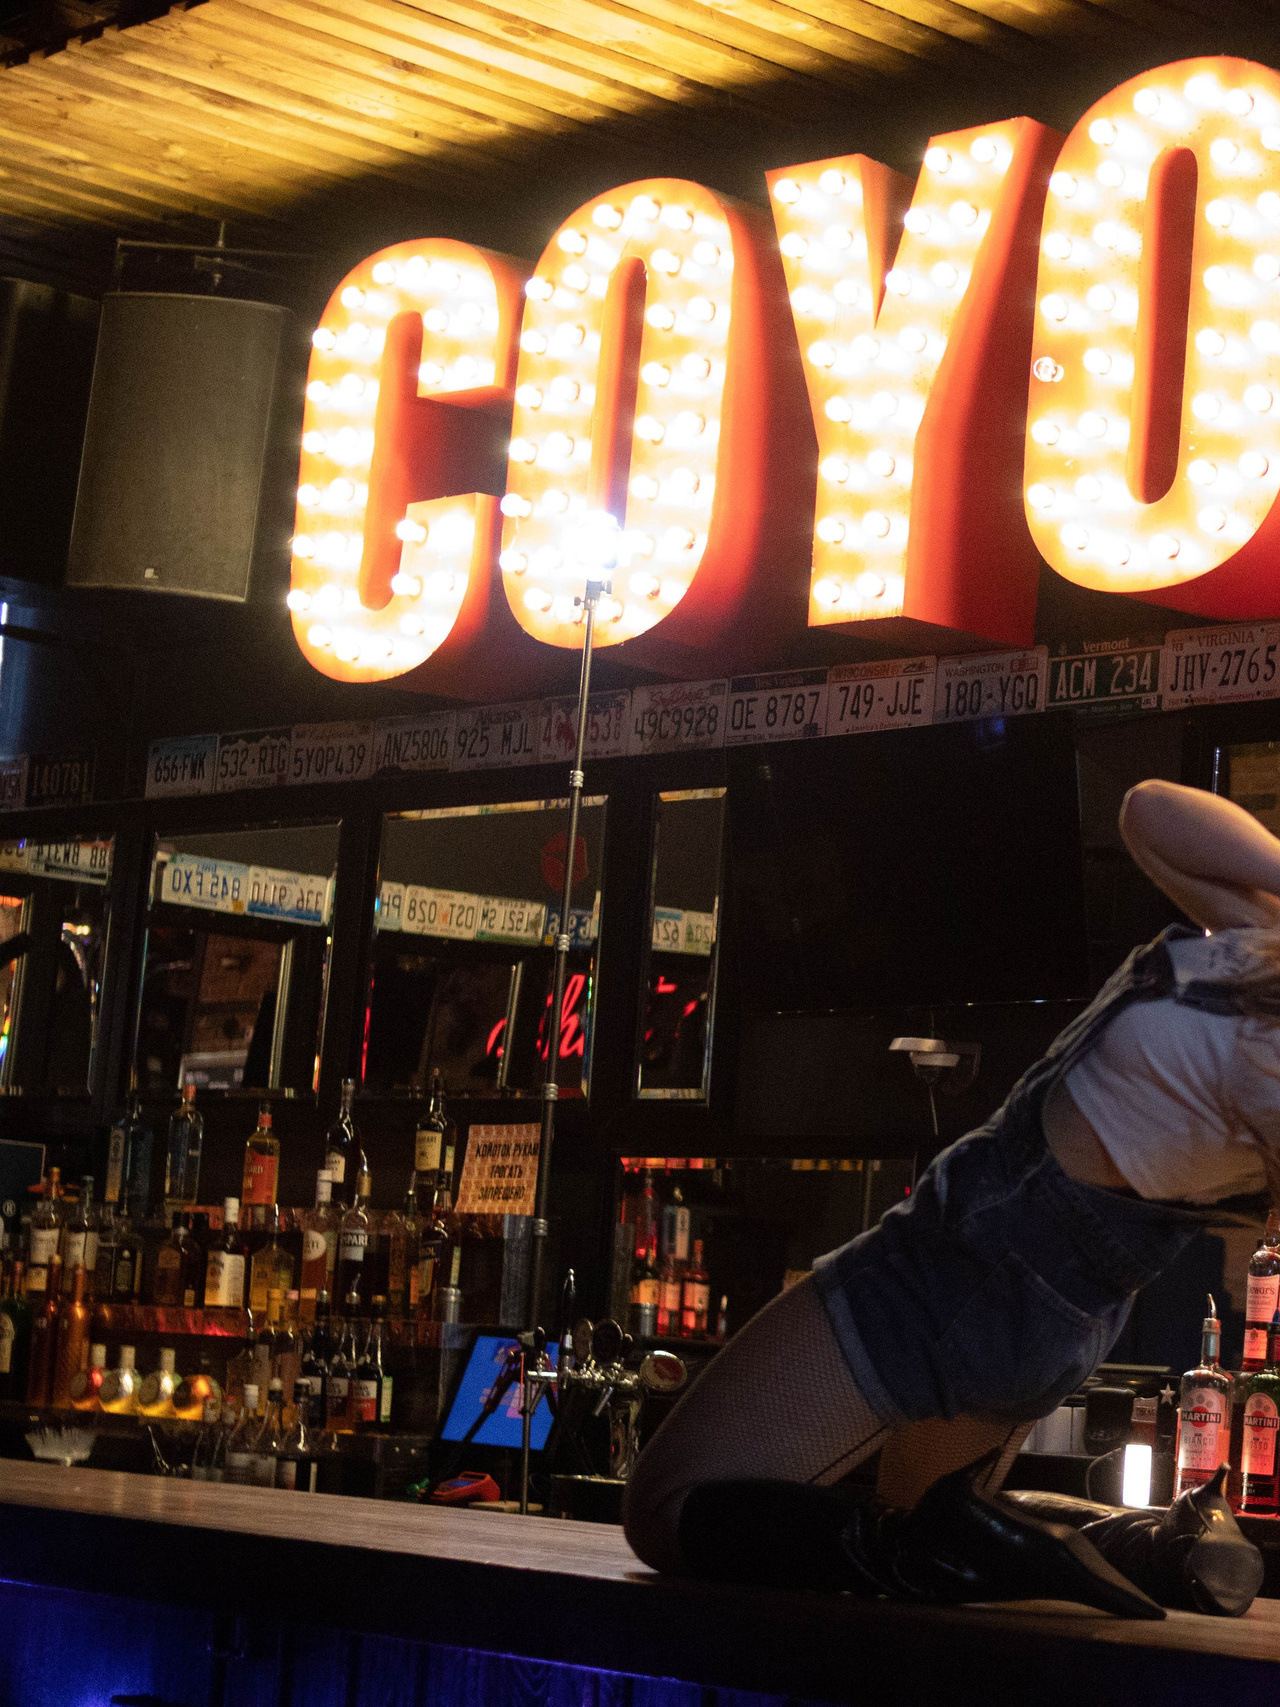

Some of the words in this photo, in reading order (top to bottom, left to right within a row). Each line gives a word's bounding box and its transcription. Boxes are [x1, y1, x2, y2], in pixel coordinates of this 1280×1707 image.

[1083, 637, 1130, 653] Vermont
[1197, 630, 1255, 648] VIRGINIA
[945, 662, 1005, 678] WASHINGTON
[1055, 659, 1097, 701] ACM
[1110, 652, 1153, 695] 234
[838, 679, 925, 721] 749-JJE
[765, 692, 820, 727] 8787
[383, 726, 449, 764] ANZ5806
[458, 726, 490, 759] 925
[501, 722, 533, 755] MJL
[1181, 1411, 1221, 1424] MARTINI
[1244, 1415, 1278, 1428] MARTINI
[1183, 1434, 1214, 1446] BIANCO
